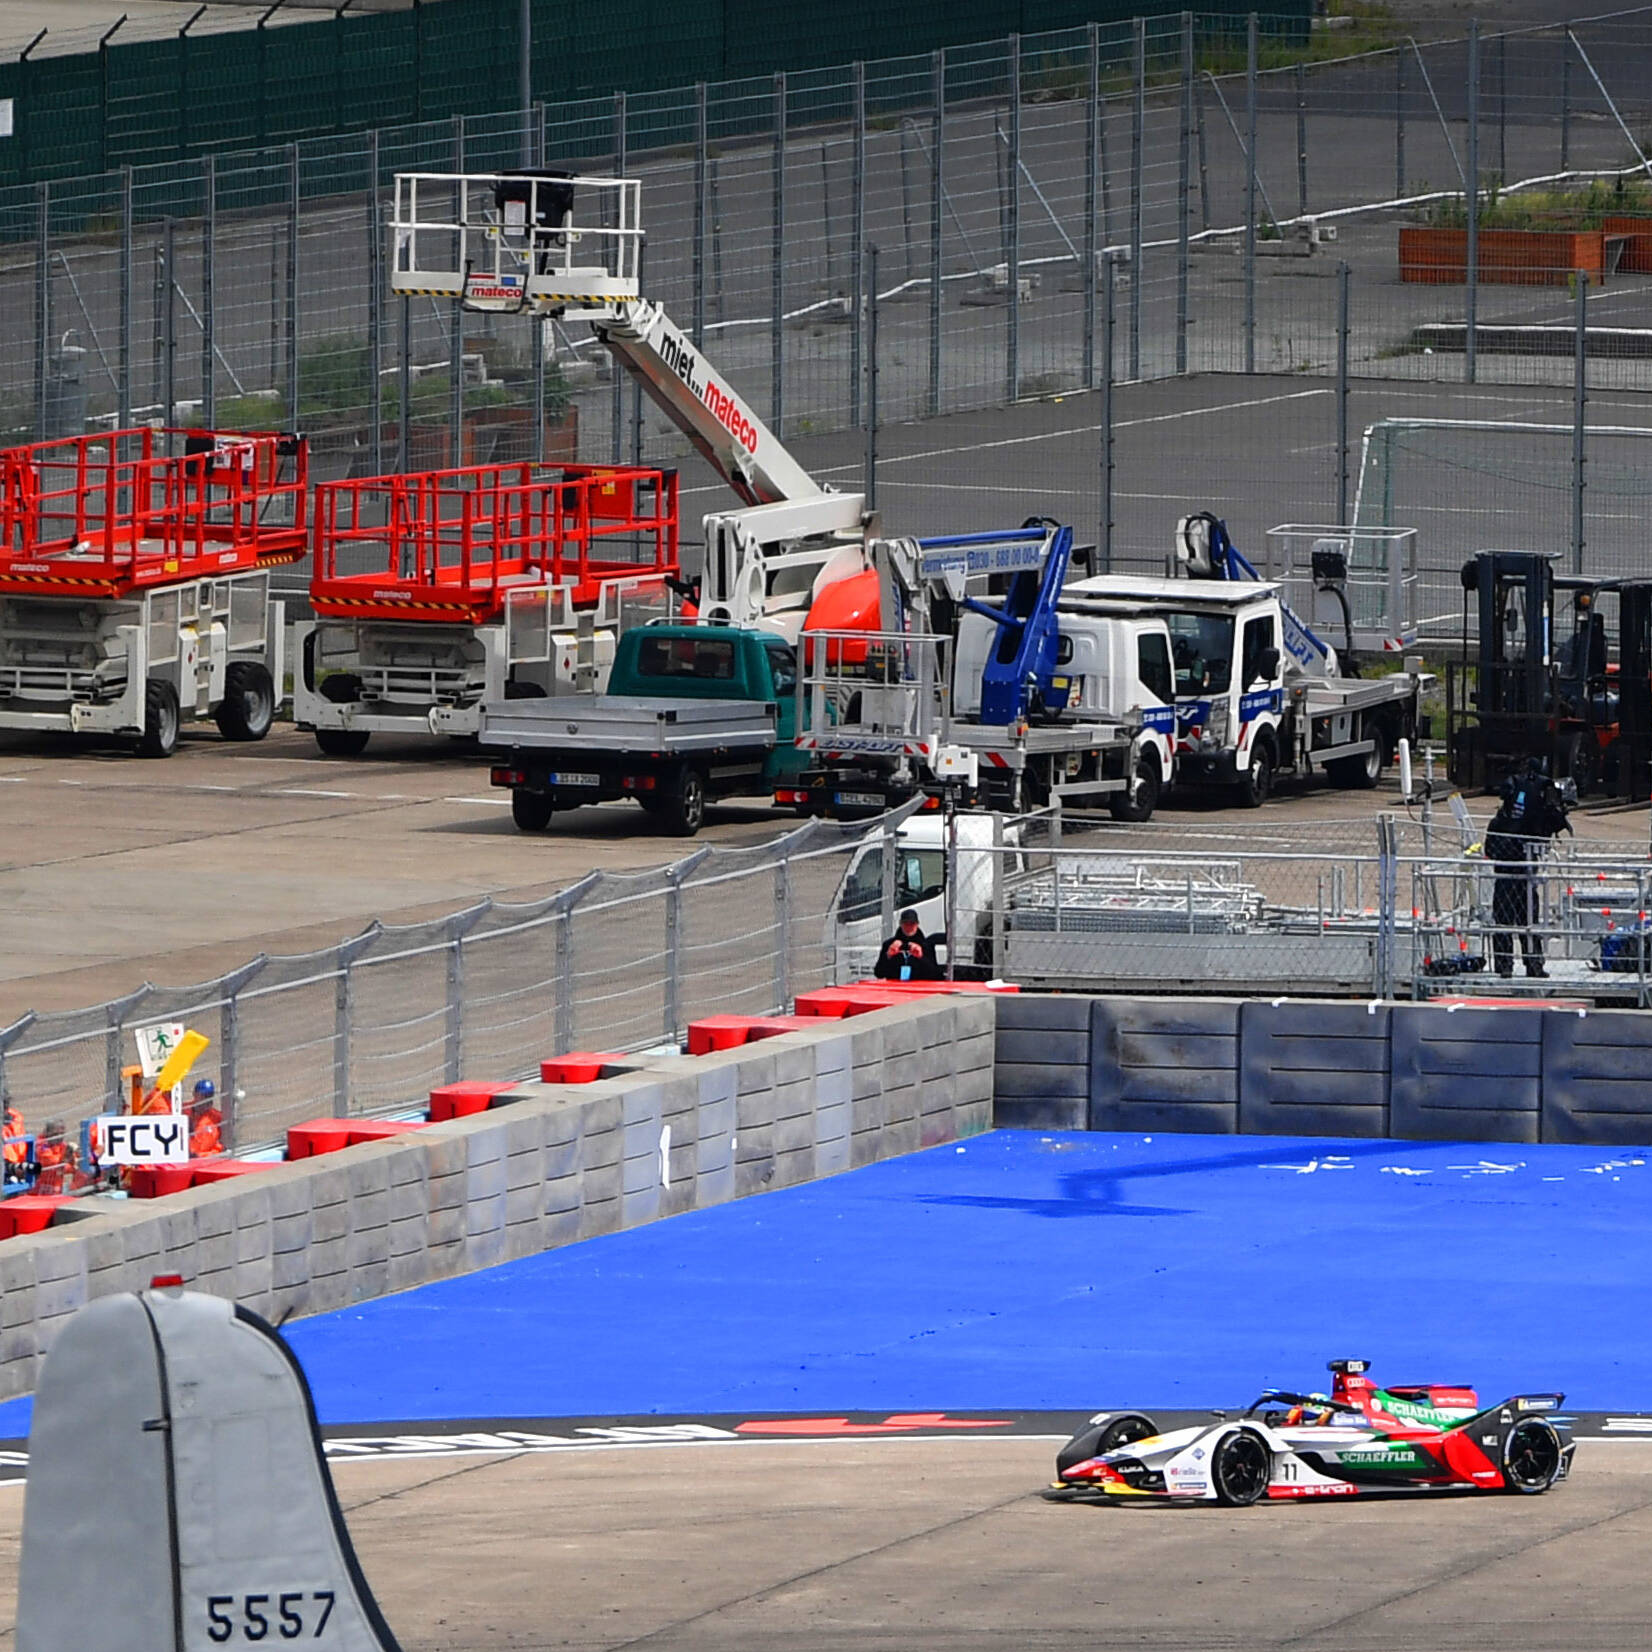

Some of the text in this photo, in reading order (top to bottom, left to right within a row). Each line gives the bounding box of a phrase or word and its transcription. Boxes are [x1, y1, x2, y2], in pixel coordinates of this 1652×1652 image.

[471, 284, 523, 298] mateco
[703, 380, 758, 454] mateco
[10, 563, 50, 573] mateco
[373, 590, 412, 600] mateco
[107, 1123, 178, 1157] FCY
[1341, 1450, 1416, 1464] SCHAEFFLER
[1282, 1463, 1298, 1481] 11
[207, 1591, 336, 1642] 5557
